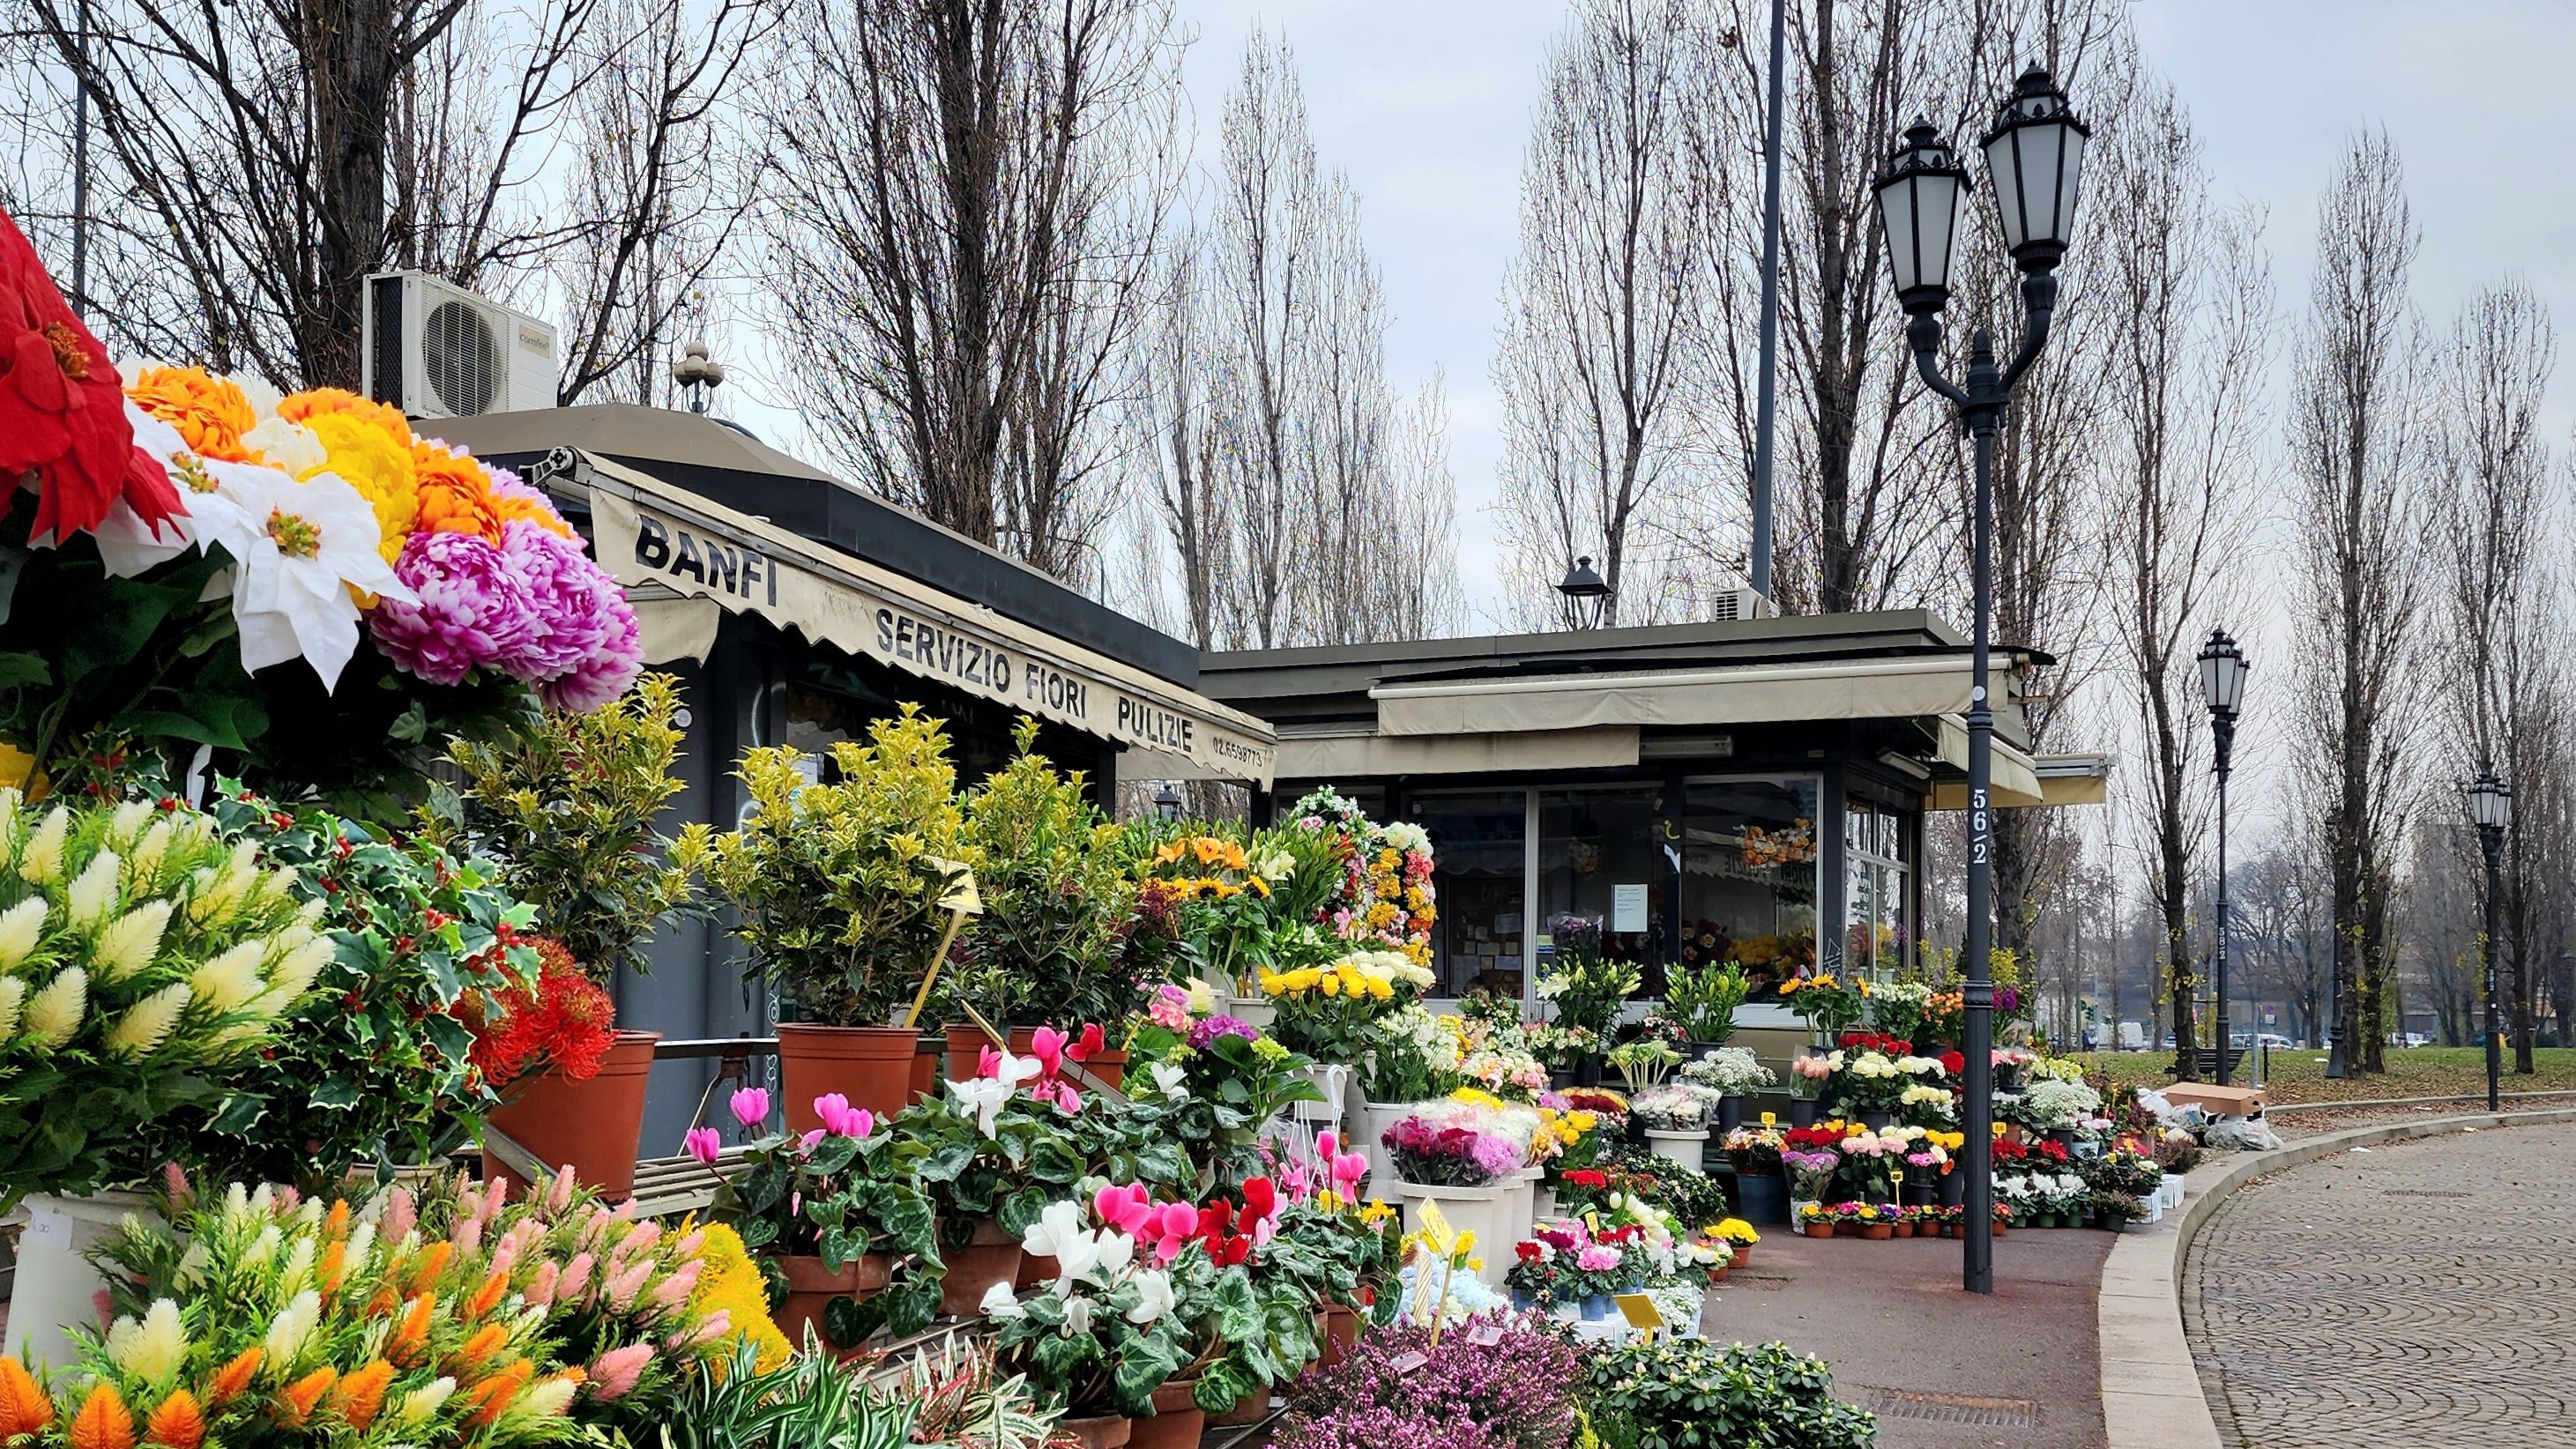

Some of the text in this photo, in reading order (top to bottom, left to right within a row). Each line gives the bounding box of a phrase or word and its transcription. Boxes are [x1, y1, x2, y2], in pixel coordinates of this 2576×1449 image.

[636, 514, 777, 607] BANFI
[876, 608, 1011, 693] SERVIZIO
[1026, 662, 1086, 720] FIORI
[1118, 695, 1193, 754] PULIZIE
[1212, 736, 1262, 768] 02.6598773
[1973, 789, 1988, 865] 56/2
